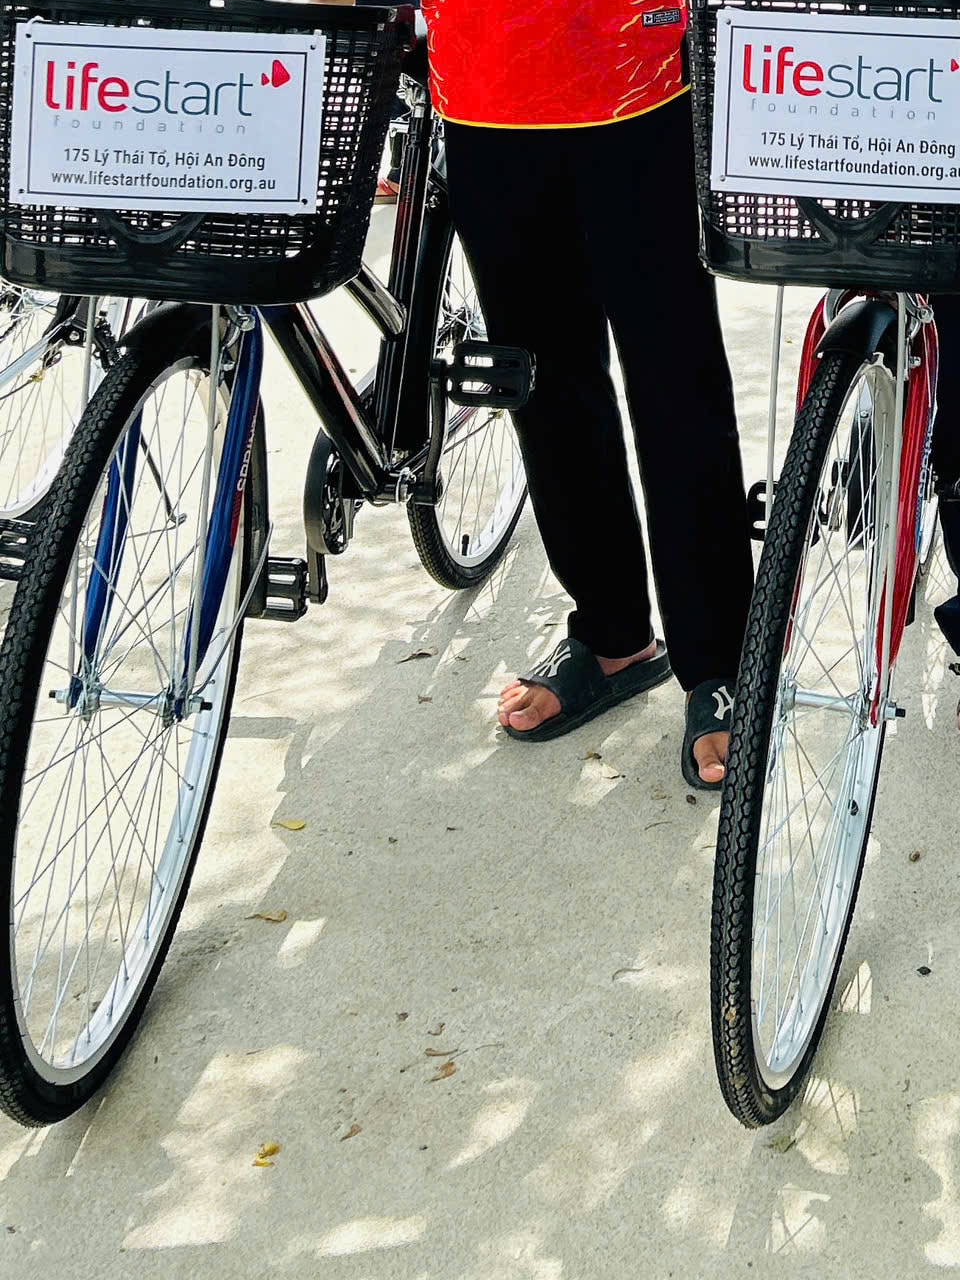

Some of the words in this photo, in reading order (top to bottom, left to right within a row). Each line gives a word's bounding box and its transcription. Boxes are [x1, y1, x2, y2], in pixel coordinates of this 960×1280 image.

[742, 44, 943, 102] lifestart
[45, 60, 253, 117] lifestart
[751, 98, 936, 121] foundation
[53, 115, 246, 134] foundation
[761, 131, 786, 146] 175
[790, 133, 804, 151] Lý
[809, 134, 838, 150] Thái
[868, 138, 892, 155] Hội
[896, 139, 915, 153] An
[919, 139, 956, 158] Đông
[64, 148, 90, 162] 175
[94, 148, 109, 166] Lý
[114, 149, 144, 164] Thái
[175, 152, 199, 169] Hội
[204, 154, 223, 167] An
[228, 152, 266, 170] Đông
[51, 171, 276, 192] www.lifestartfoundation.org.au
